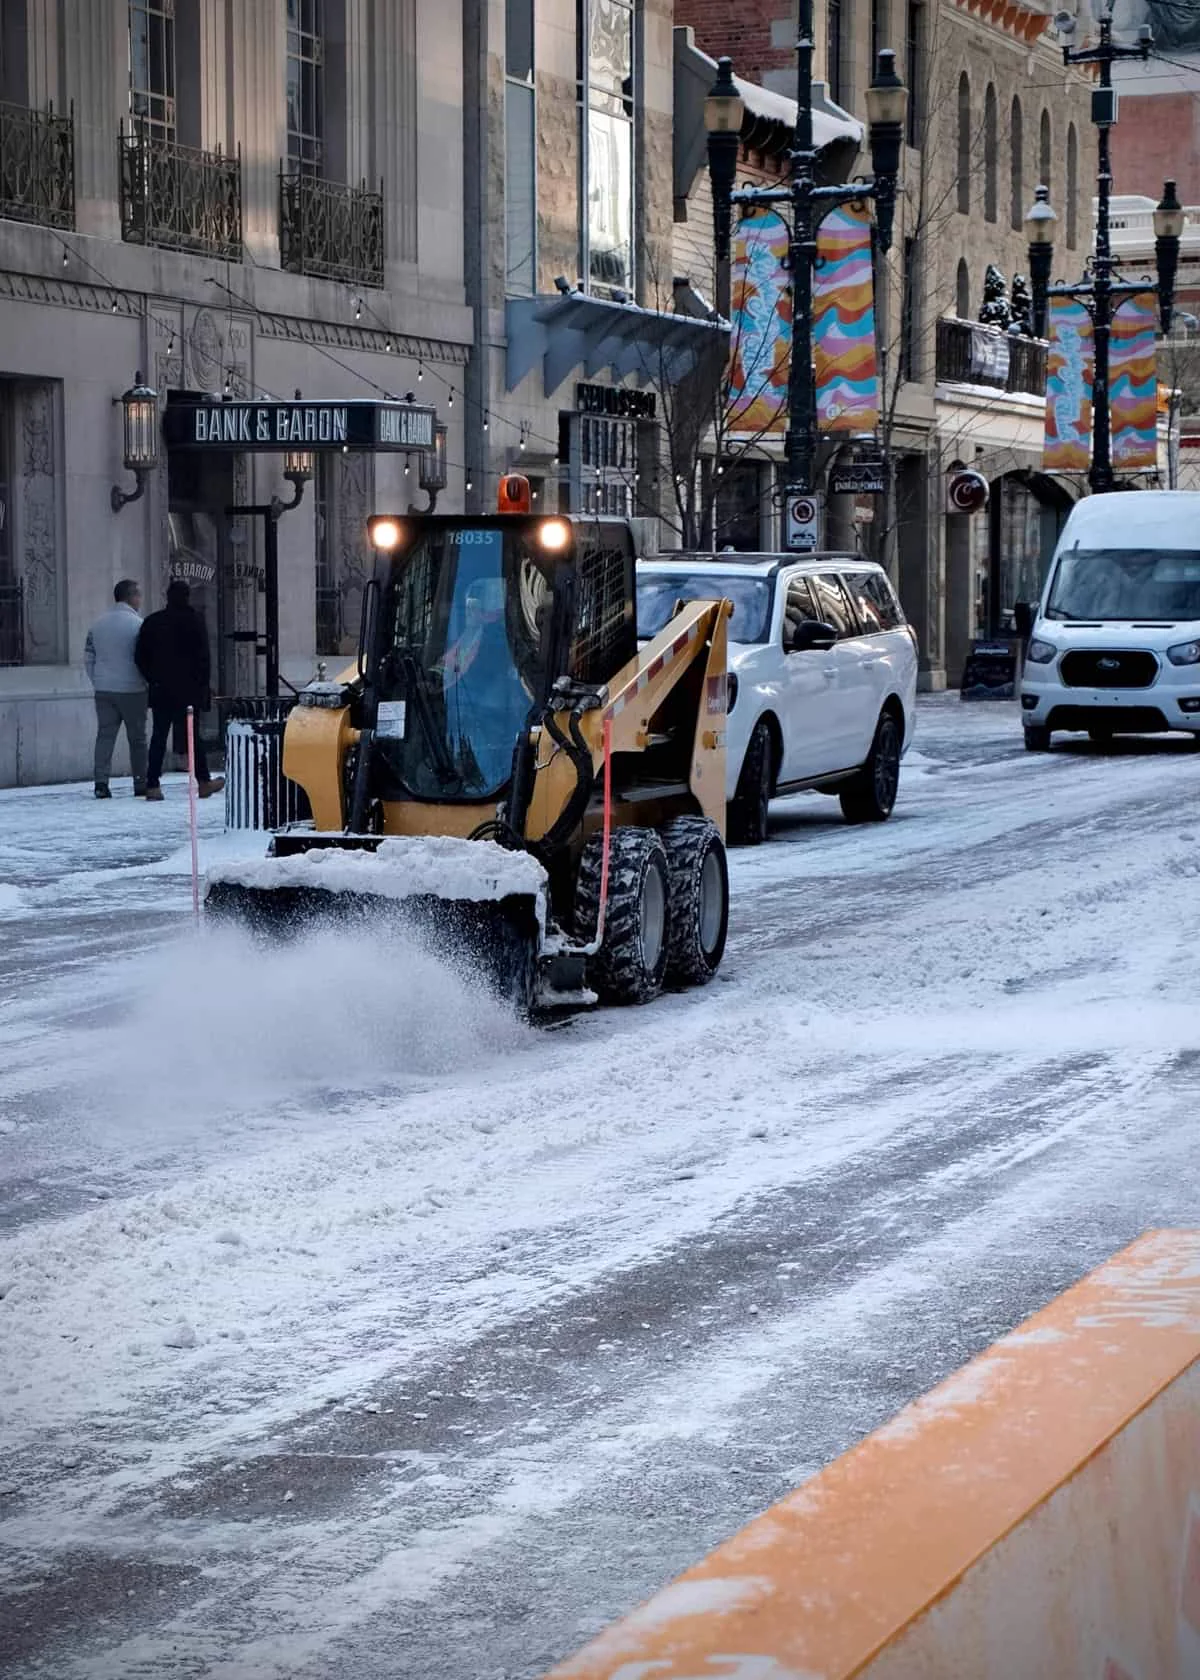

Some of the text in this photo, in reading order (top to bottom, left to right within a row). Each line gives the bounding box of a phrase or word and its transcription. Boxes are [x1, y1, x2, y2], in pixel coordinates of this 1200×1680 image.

[195, 408, 348, 441] BANK & BARON
[448, 530, 494, 545] 18035
